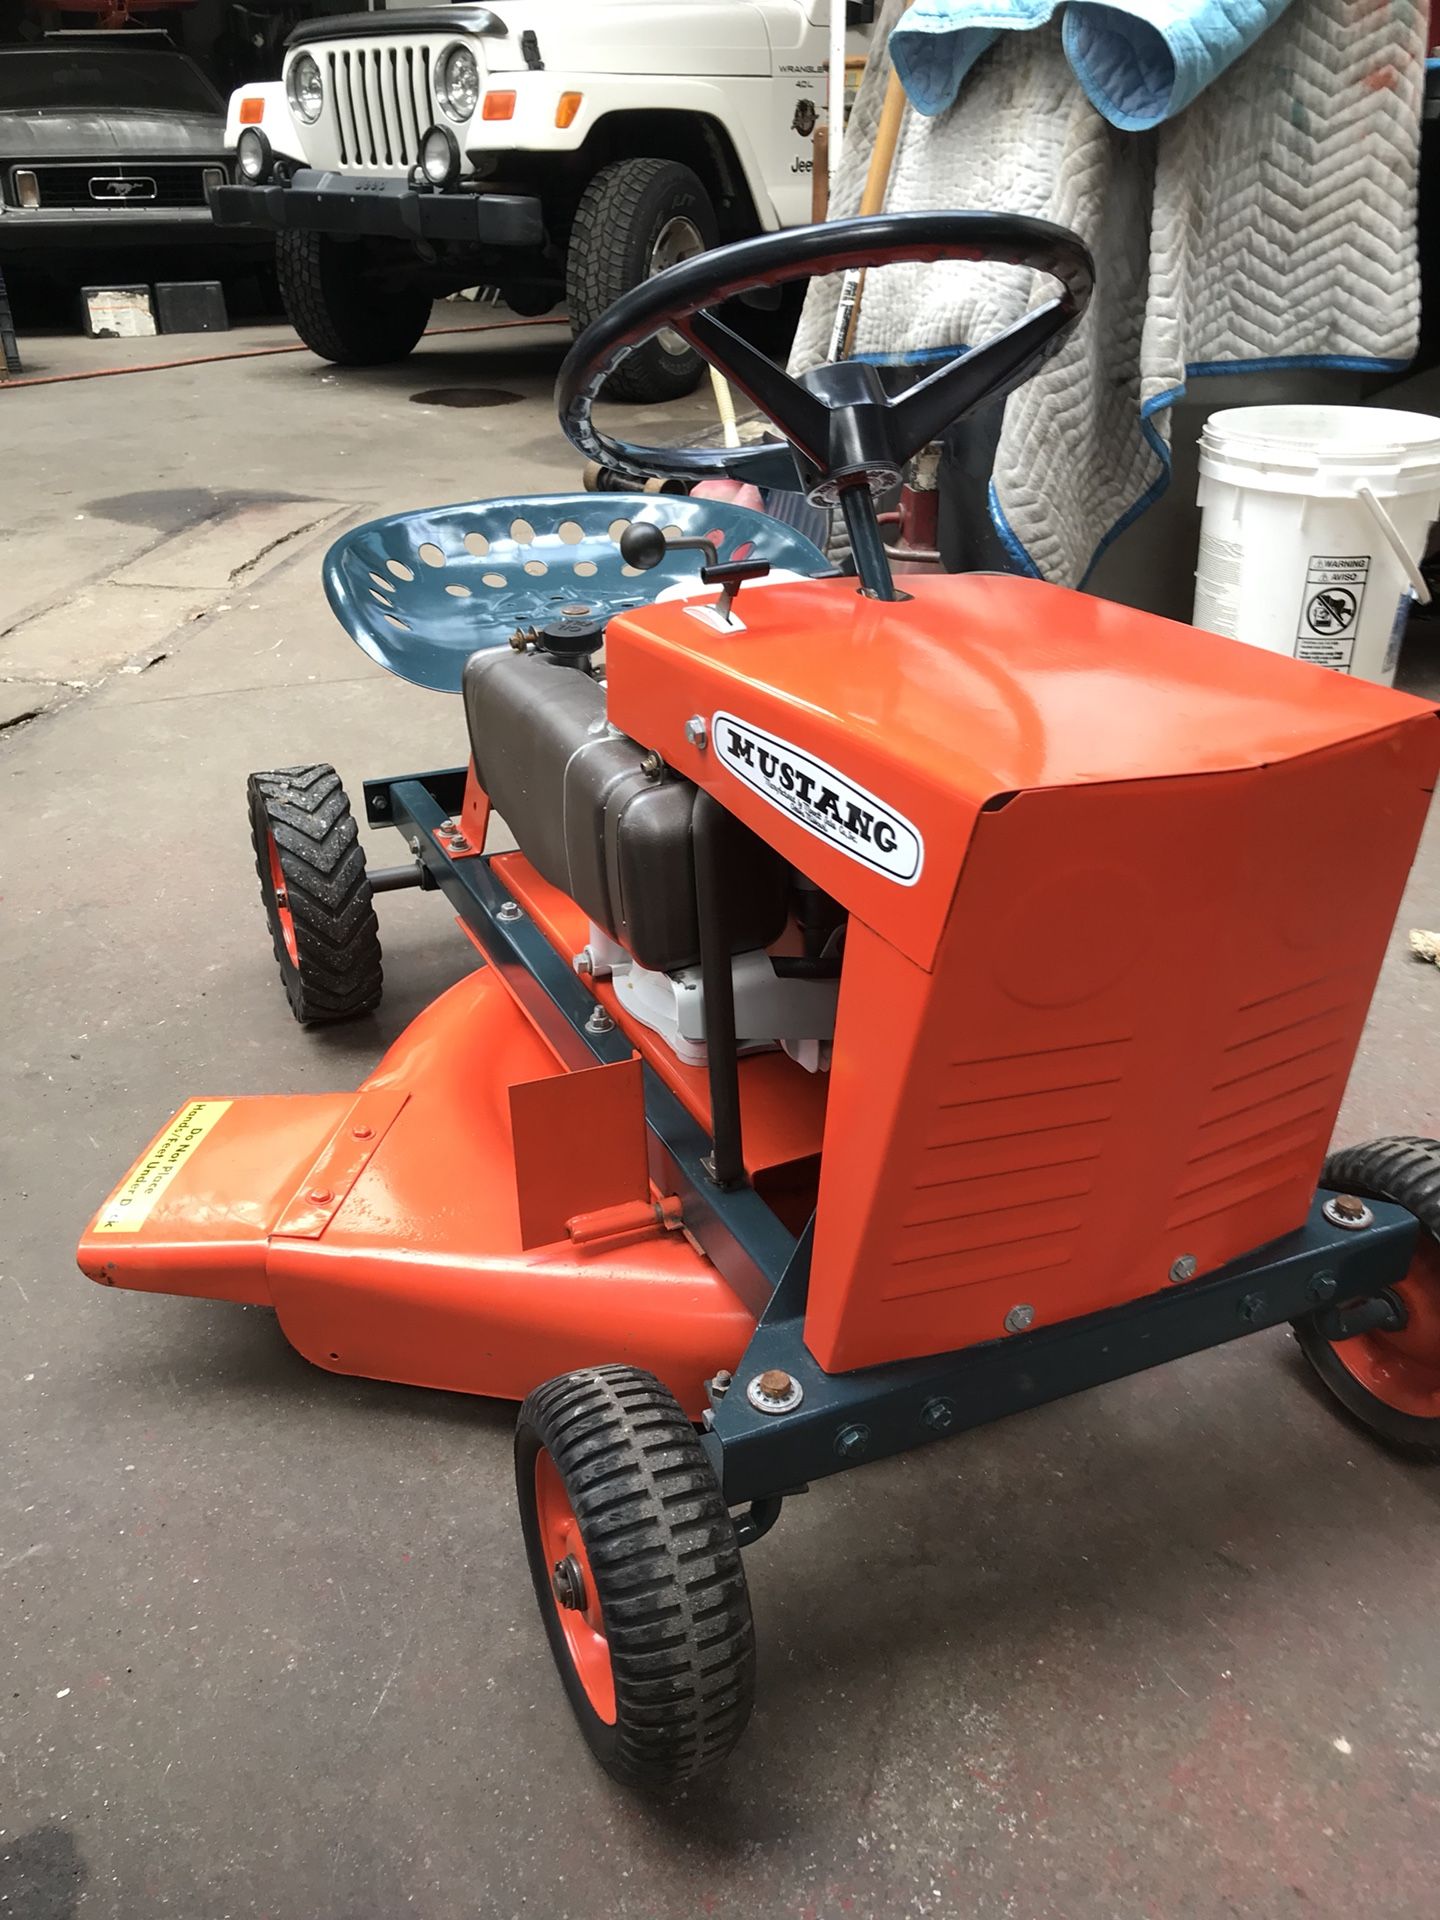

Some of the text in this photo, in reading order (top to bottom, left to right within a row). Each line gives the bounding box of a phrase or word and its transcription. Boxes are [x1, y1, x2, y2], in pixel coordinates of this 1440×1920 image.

[778, 65, 826, 73] WRANGLE
[791, 156, 814, 173] Jee
[1324, 559, 1366, 568] WARNING
[1331, 573, 1358, 581] AVISO
[727, 728, 898, 853] MUSTANG
[155, 1104, 206, 1159] Hands/Feet
[144, 1127, 203, 1194] Do Not Place
[128, 1161, 160, 1195] Under
